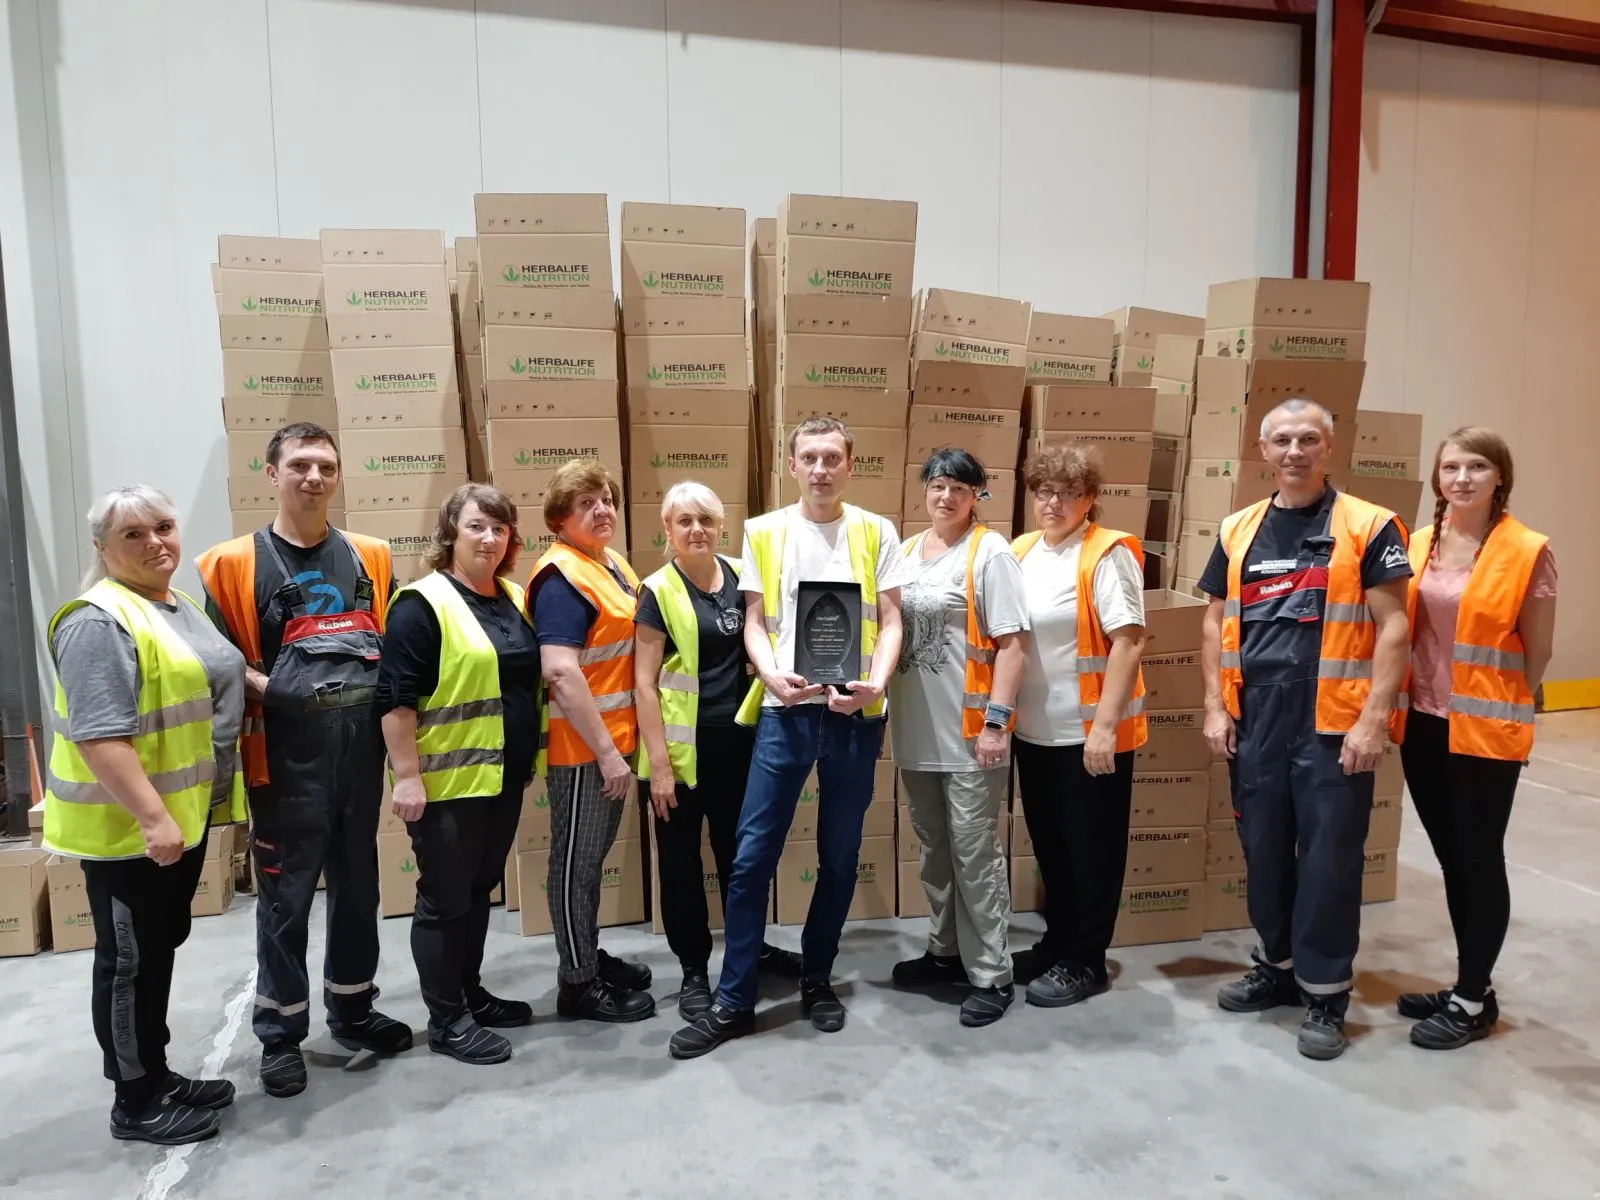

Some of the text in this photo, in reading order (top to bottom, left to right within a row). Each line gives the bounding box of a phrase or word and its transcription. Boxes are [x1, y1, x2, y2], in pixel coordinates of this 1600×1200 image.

[522, 264, 589, 273] HERBALIFE
[522, 273, 590, 282] NUTRITION
[661, 272, 724, 283] HERBALIFE
[827, 269, 892, 281] HERBALIFE
[661, 281, 724, 291] NUTRITION
[826, 279, 892, 290] NUTRITION
[364, 290, 427, 299] HERBALIFE
[260, 297, 322, 307] HERBALIFE
[364, 298, 428, 306] NUTRITION
[260, 305, 323, 315] NUTRITION
[1286, 335, 1348, 347] HERBALIFE
[951, 341, 1010, 356] HERBALIFE
[950, 350, 1009, 364] NUTRITION
[528, 357, 595, 368] HERBALIFE
[1044, 361, 1096, 372] HERBALIFE
[528, 366, 595, 376] NUTRITION
[664, 364, 725, 373] HERBALIFE
[824, 366, 888, 376] HERBALIFE
[261, 376, 324, 385] HERBALIFE
[373, 373, 436, 382] HERBALIFE
[664, 372, 726, 381] NUTRITION
[823, 374, 888, 384] NUTRITION
[262, 383, 324, 392] NUTRITION
[374, 380, 437, 390] NUTRITION
[946, 412, 1005, 422] HERBALIFE
[533, 448, 599, 457] HERBALIFE
[667, 453, 728, 462] HERBALIFE
[382, 454, 446, 463] HERBALIFE
[853, 456, 885, 465] ALIFE
[382, 462, 447, 471] NUTRITION
[667, 461, 729, 469] NUTRITION
[851, 463, 884, 472] ITION
[1358, 460, 1407, 470] HERBALIFE
[389, 536, 432, 544] HERBAL
[390, 543, 430, 551] NUTRI
[1260, 581, 1293, 594] Raben
[318, 620, 353, 630] Raben
[1141, 656, 1195, 665] ERBALIFE
[1146, 714, 1195, 724] ERBALIFE
[1130, 888, 1190, 900] HERBALIFE
